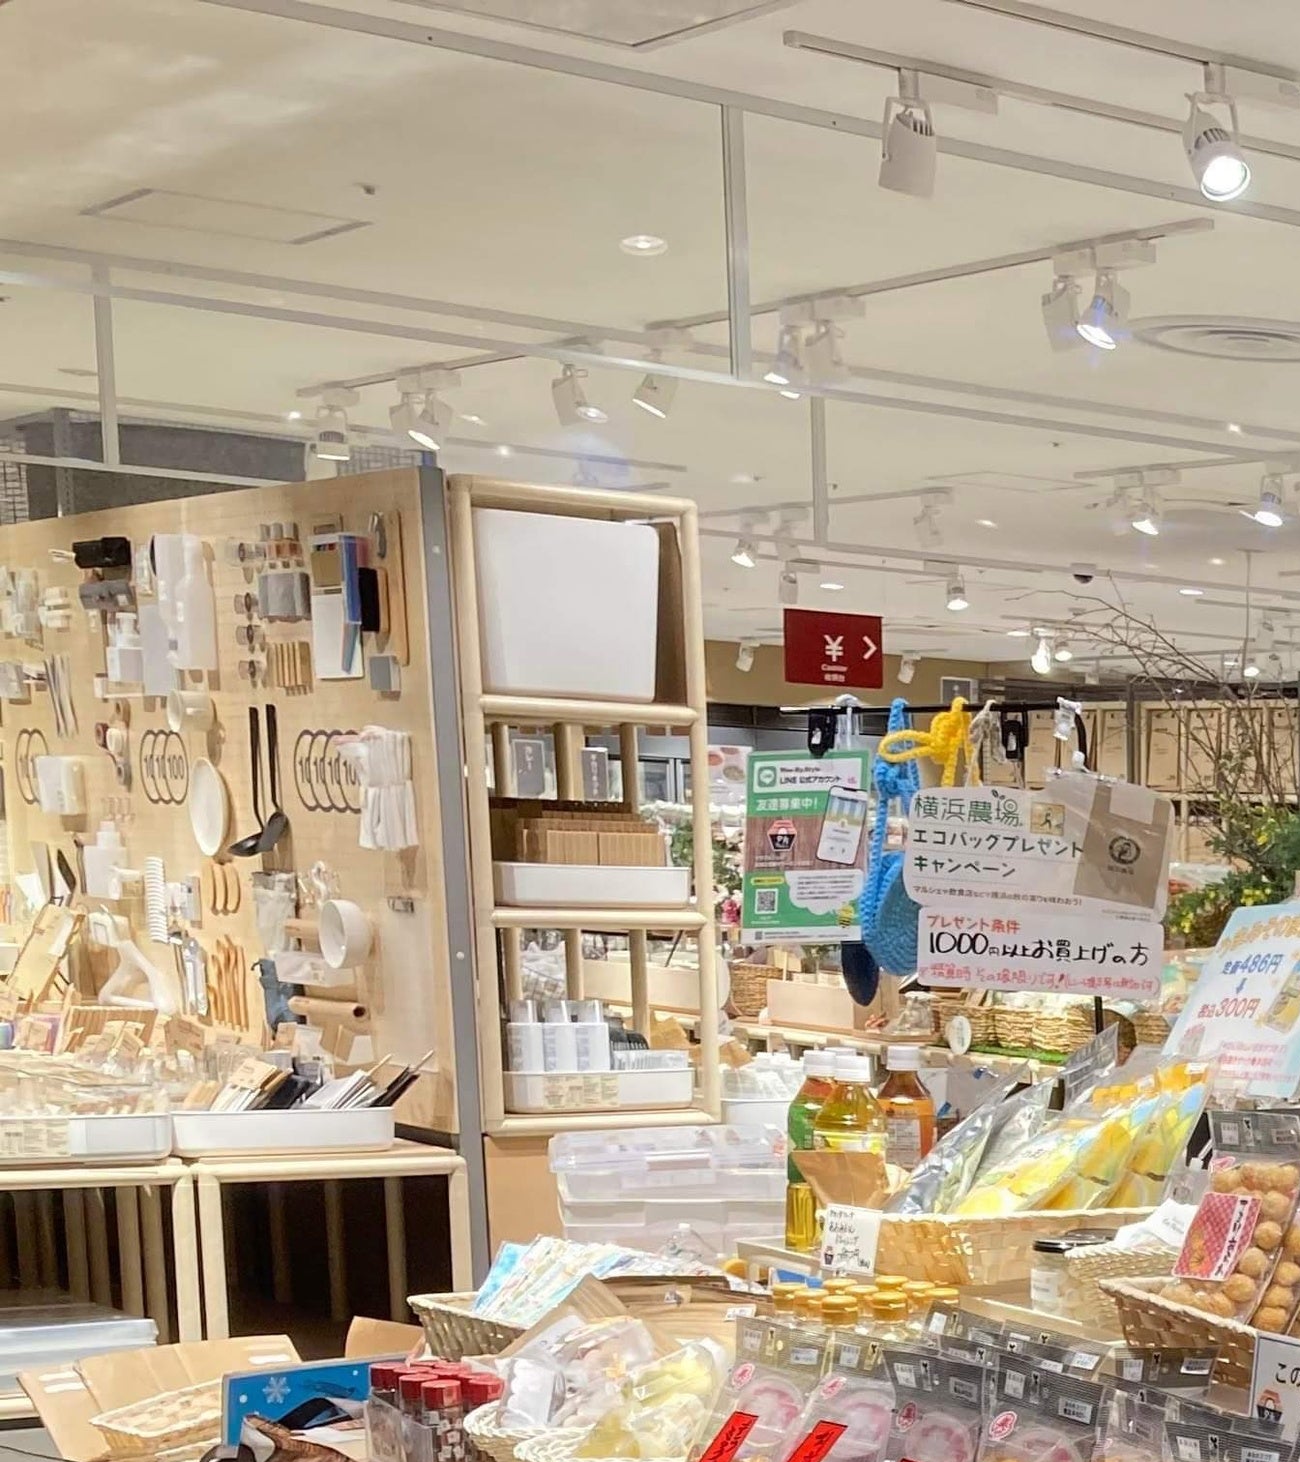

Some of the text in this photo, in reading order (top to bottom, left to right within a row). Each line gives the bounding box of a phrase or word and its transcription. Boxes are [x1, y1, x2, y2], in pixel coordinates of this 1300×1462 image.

[914, 795, 1019, 828] 横浜農場
[914, 855, 1016, 878] キャンペーン
[927, 914, 1021, 935] プレゼント条件
